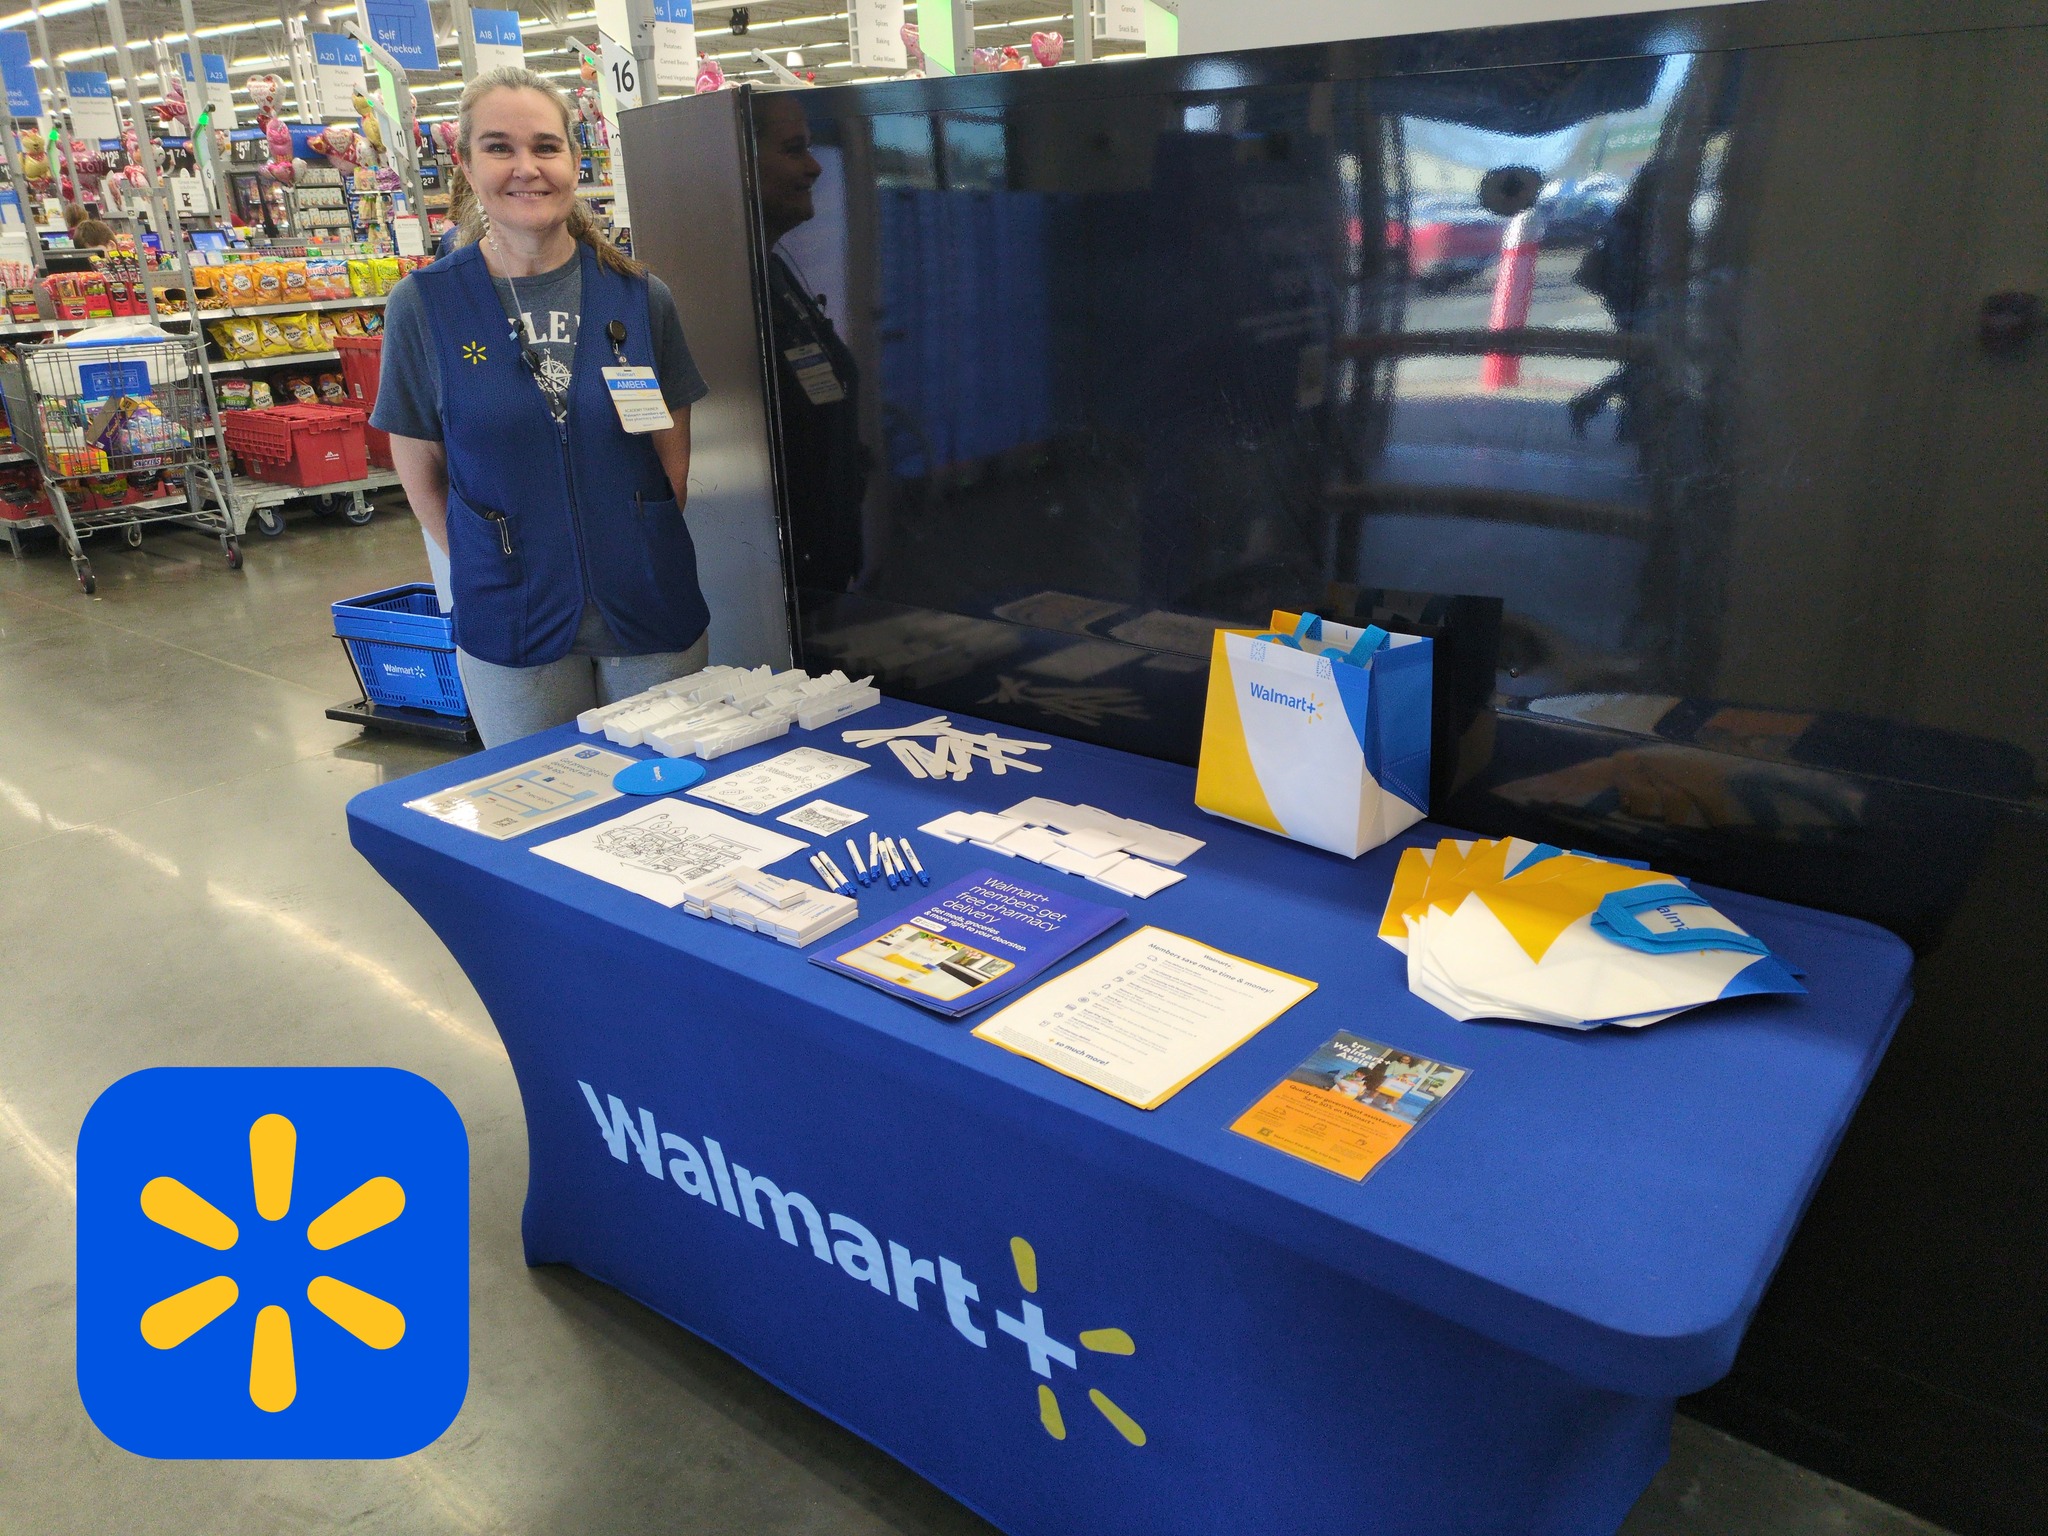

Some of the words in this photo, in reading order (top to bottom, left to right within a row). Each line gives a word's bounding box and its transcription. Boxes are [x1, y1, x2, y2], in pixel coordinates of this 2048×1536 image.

[675, 8, 687, 18] A17
[378, 29, 396, 40] Self
[480, 31, 493, 39] A18
[503, 32, 516, 40] A19
[381, 43, 422, 54] Checkout
[320, 52, 335, 61] A20
[344, 53, 357, 62] A21
[210, 71, 224, 79] A23
[612, 60, 634, 93] 16
[206, 169, 212, 179] 6
[617, 380, 648, 389] AMBER
[383, 663, 415, 676] Walmart
[1250, 682, 1316, 713] Walmart+
[983, 877, 1050, 903] Walmart+
[969, 885, 1040, 913] members
[1036, 908, 1068, 922] get
[942, 899, 1001, 924] delivery
[956, 891, 986, 907] free
[982, 902, 1060, 932] pharmacy
[930, 906, 946, 916] Get
[964, 919, 1000, 935] groceries
[929, 912, 950, 923] more
[948, 917, 967, 930] right
[965, 924, 976, 932] to
[973, 928, 994, 939] your
[991, 933, 1027, 952] doorstep.
[1148, 943, 1181, 960] Members
[1181, 956, 1198, 966] save
[1198, 962, 1218, 974] more
[1218, 970, 1237, 981] time
[1243, 980, 1275, 994] money!
[1333, 1041, 1391, 1065] Walmart+
[1351, 1041, 1371, 1052] try
[1064, 1044, 1086, 1056] much
[1085, 1053, 1111, 1066] more!
[1336, 1052, 1377, 1070] Assist
[1289, 1084, 1315, 1096] Qualify
[577, 1080, 1077, 1379] Walmart+
